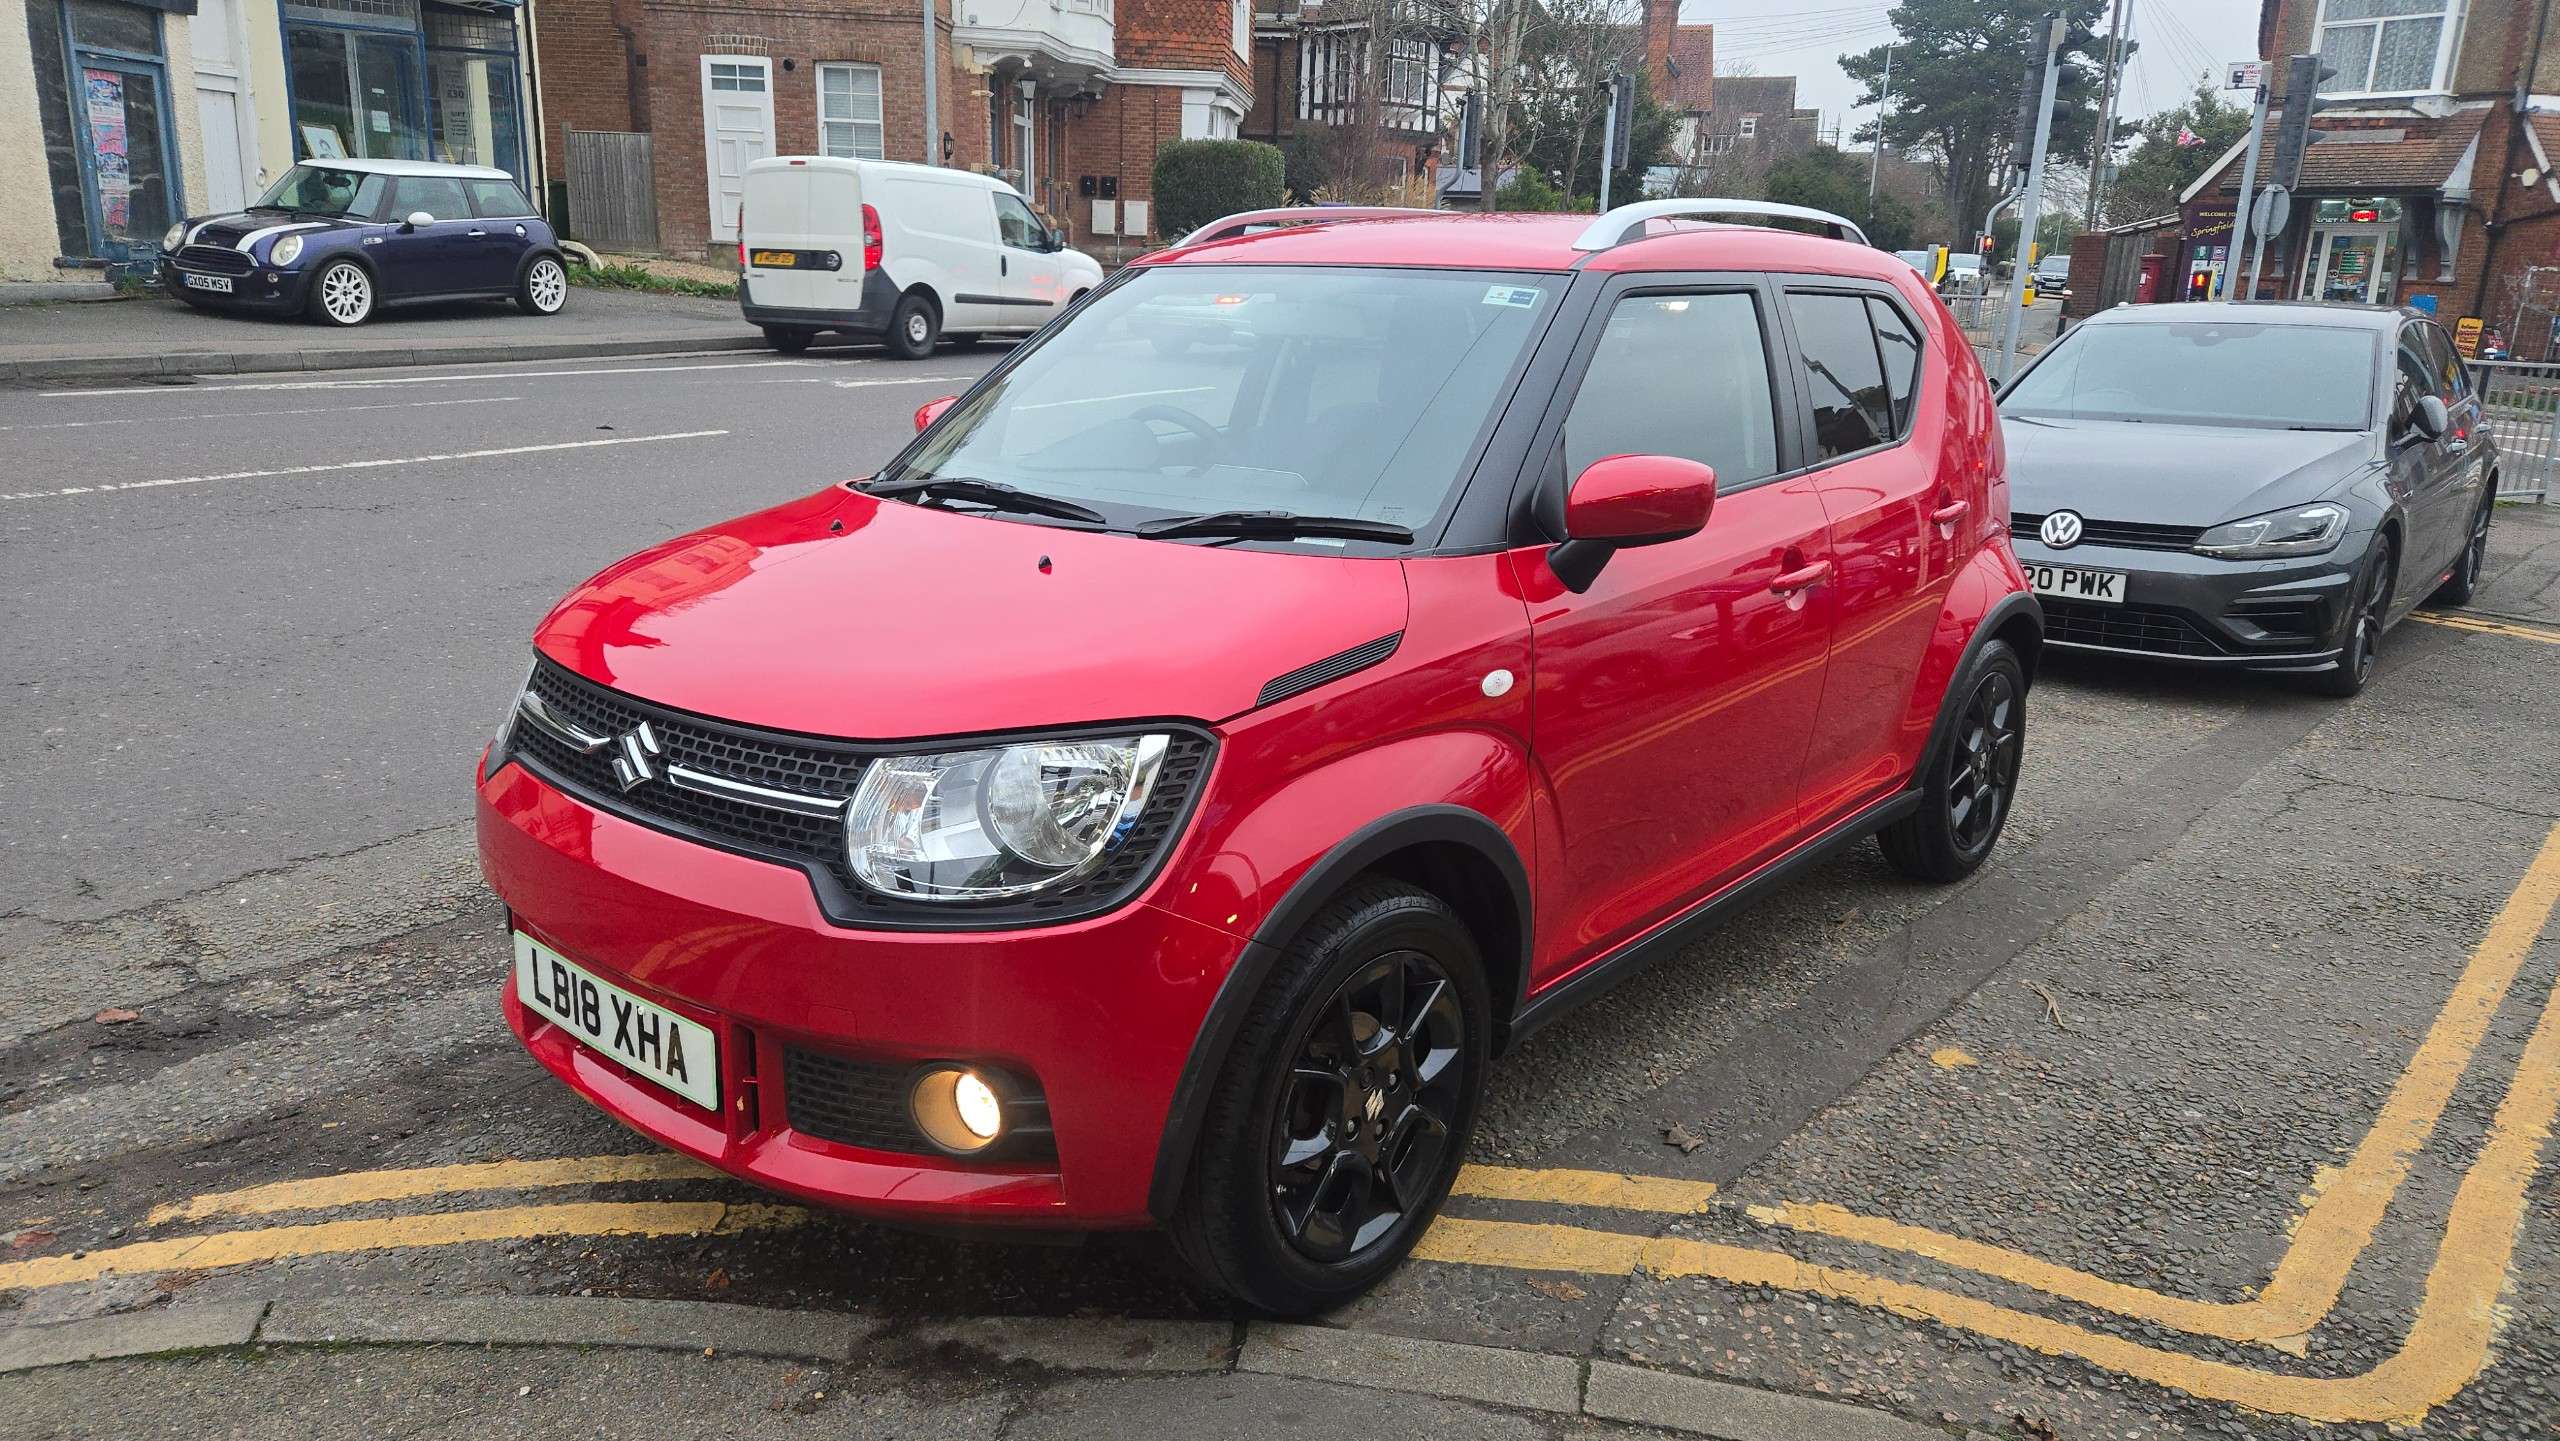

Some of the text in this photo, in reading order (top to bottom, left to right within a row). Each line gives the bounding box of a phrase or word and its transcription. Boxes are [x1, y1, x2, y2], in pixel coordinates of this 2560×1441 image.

[187, 275, 210, 288] GX05
[2060, 569, 2116, 598] PWK
[530, 947, 690, 1084] LB18 XHA
